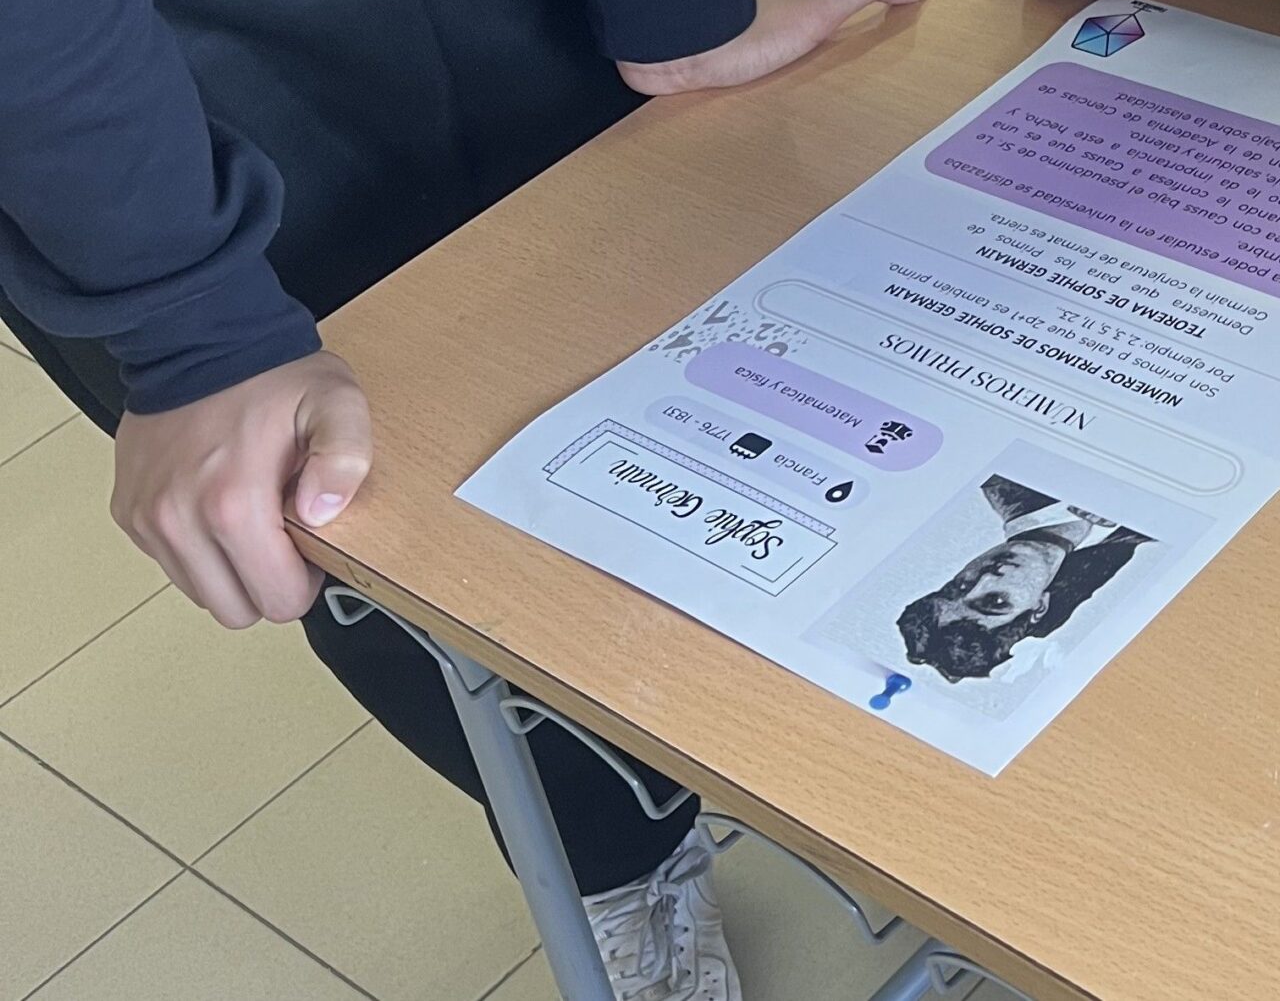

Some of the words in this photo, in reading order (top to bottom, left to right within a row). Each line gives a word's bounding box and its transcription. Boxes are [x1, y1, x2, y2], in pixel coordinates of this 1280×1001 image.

[1037, 84, 1057, 94] de
[1005, 107, 1021, 116] y
[1059, 91, 1117, 115] Ciencias
[1113, 91, 1192, 121] elasticidad.
[1025, 112, 1069, 135] hecho,
[1122, 111, 1142, 122] de
[1193, 117, 1208, 128] la
[991, 120, 1019, 134] una
[1023, 131, 1042, 141] es
[1146, 119, 1219, 148] Academia
[1208, 121, 1250, 139] sobre
[975, 133, 994, 145] Le
[997, 139, 1016, 151] Sr.
[1047, 139, 1076, 153] que
[1073, 130, 1104, 144] este
[1109, 142, 1121, 150] a
[1129, 130, 1181, 153] talento.
[1016, 147, 1037, 158] de
[1180, 147, 1196, 157] y
[1222, 143, 1238, 155] la
[1242, 149, 1263, 161] de
[1080, 150, 1124, 171] Gauss
[1126, 147, 1213, 183] importancia
[1193, 151, 1262, 178] sabiduría
[943, 157, 1013, 187] disfrazaba
[1038, 154, 1130, 189] pseudónimo
[1131, 167, 1142, 176] a
[1014, 183, 1033, 193] se
[1126, 185, 1145, 195] el
[1147, 173, 1209, 198] confiesa
[1219, 178, 1240, 190] da
[1246, 187, 1261, 199] le
[1030, 189, 1116, 223] universidad
[1147, 191, 1181, 209] bajo
[1215, 196, 1232, 208] le
[990, 212, 1029, 232] cierta.
[1182, 203, 1228, 225] Gauss
[966, 223, 986, 235] de
[1029, 228, 1047, 238] es
[1118, 218, 1134, 231] la
[1135, 225, 1156, 237] en
[1232, 219, 1262, 235] con
[994, 234, 1045, 258] Primos
[1046, 234, 1098, 259] Fermat
[1156, 233, 1220, 259] estudiar
[975, 245, 1048, 277] GERMAIN
[1053, 256, 1076, 270] los
[1098, 253, 1118, 265] de
[1220, 256, 1271, 277] poder
[888, 262, 933, 283] primo.
[1086, 267, 1122, 284] para
[1119, 260, 1188, 289] conjetura
[931, 279, 990, 307] también
[1045, 271, 1107, 299] SOPHIE
[1130, 283, 1160, 298] que
[1188, 286, 1204, 298] la
[883, 283, 956, 317] GERMAIN
[991, 303, 1010, 314] es
[1103, 293, 1130, 309] DE
[1204, 291, 1268, 321] Germain
[953, 311, 1015, 340] SOPHIE
[1010, 310, 1045, 329] 2p+1
[1081, 315, 1096, 330] 11,
[1131, 301, 1206, 338] TEOREMA
[1171, 298, 1254, 335] Demuestra
[1046, 324, 1076, 340] que
[1097, 321, 1112, 335] 5,
[1112, 327, 1126, 341] 3,
[1011, 333, 1038, 349] DE
[1077, 336, 1114, 356] tales
[1127, 333, 1141, 346] 2,
[878, 333, 974, 379] PRIMOS
[1034, 343, 1103, 375] PRIMOS
[1117, 351, 1132, 361] p
[1139, 340, 1205, 369] ejemplo:
[734, 366, 770, 387] física
[1131, 357, 1188, 383] primos
[1205, 366, 1235, 383] Por
[767, 380, 785, 390] y
[1100, 368, 1183, 407] NÚMEROS
[1188, 379, 1220, 398] Son
[779, 385, 863, 428] Matemática
[969, 370, 1096, 431] NÚMEROS
[661, 405, 693, 424] 1831
[697, 421, 732, 442] 1776
[773, 454, 828, 486] Francia
[608, 459, 703, 518] Germain
[703, 508, 783, 560] Sophie
